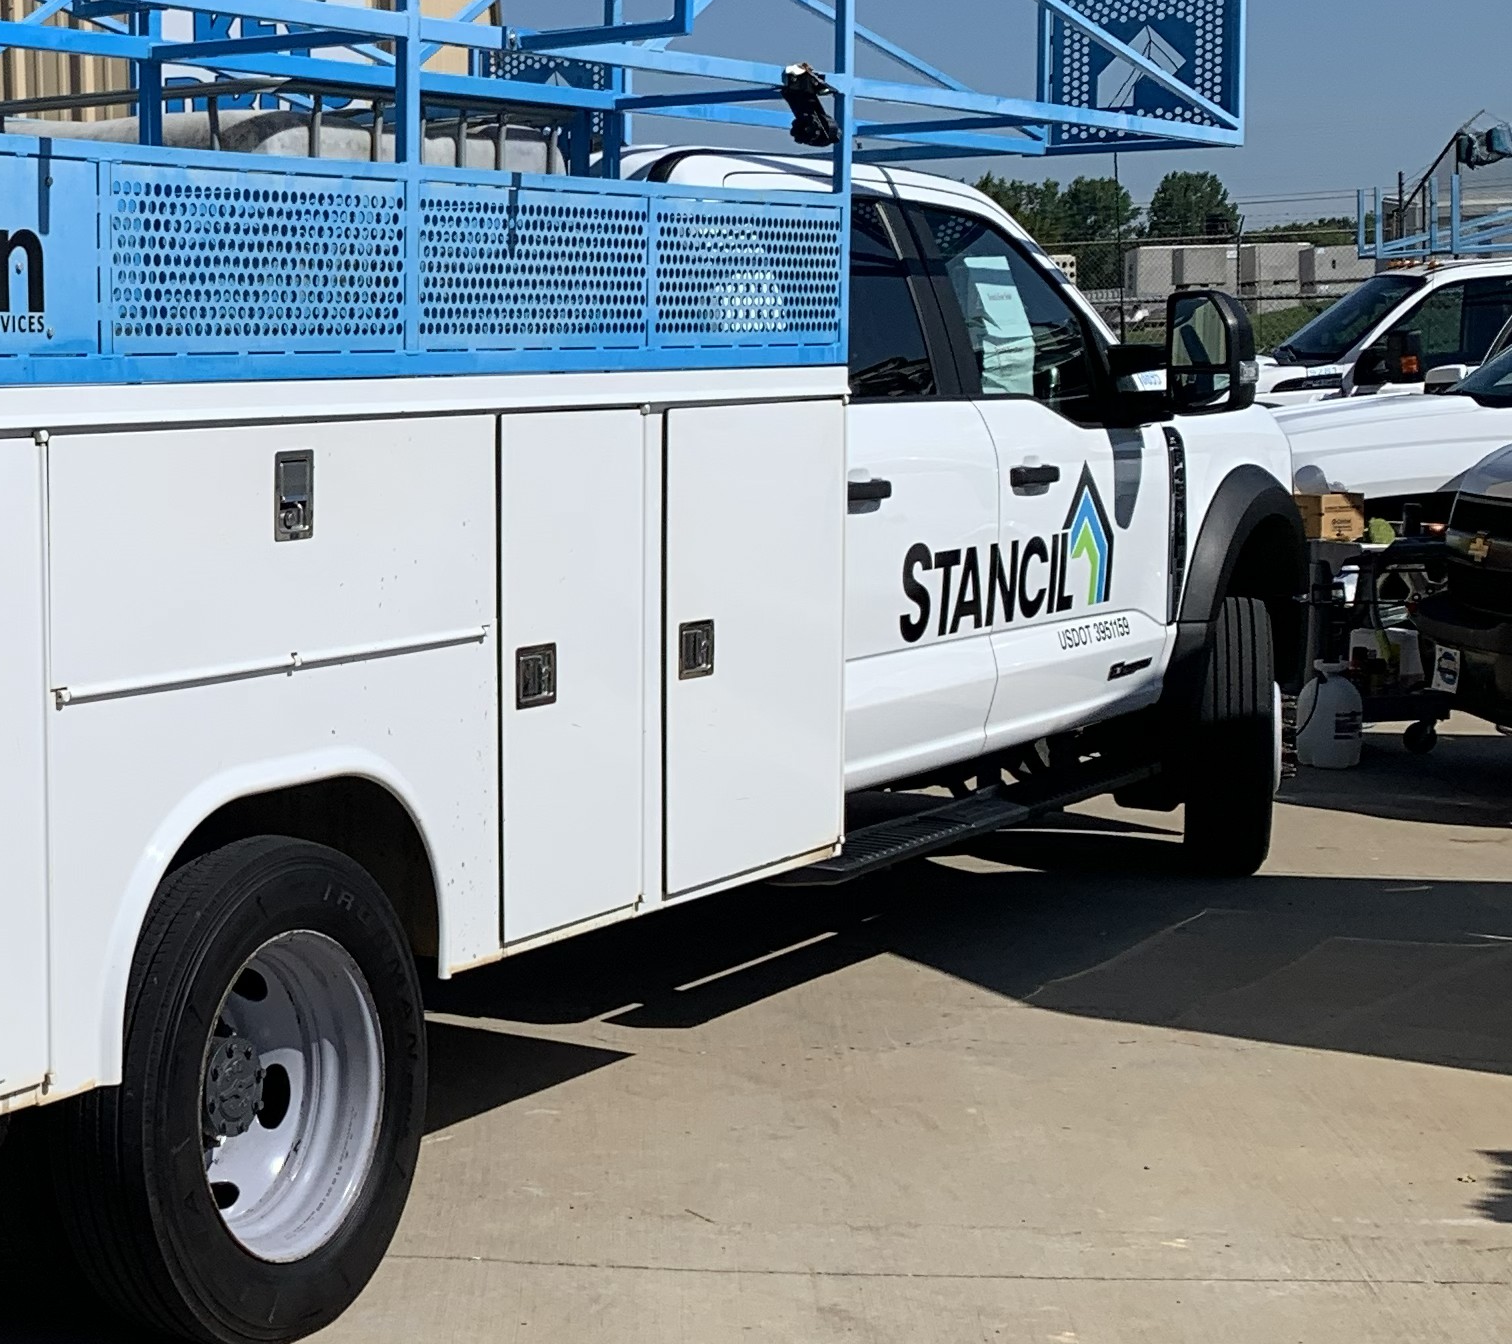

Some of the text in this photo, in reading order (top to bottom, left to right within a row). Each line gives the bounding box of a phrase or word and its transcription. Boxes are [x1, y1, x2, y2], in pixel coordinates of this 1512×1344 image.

[899, 528, 1073, 644] STANCIL
[1057, 617, 1131, 651] USDOT 3951159
